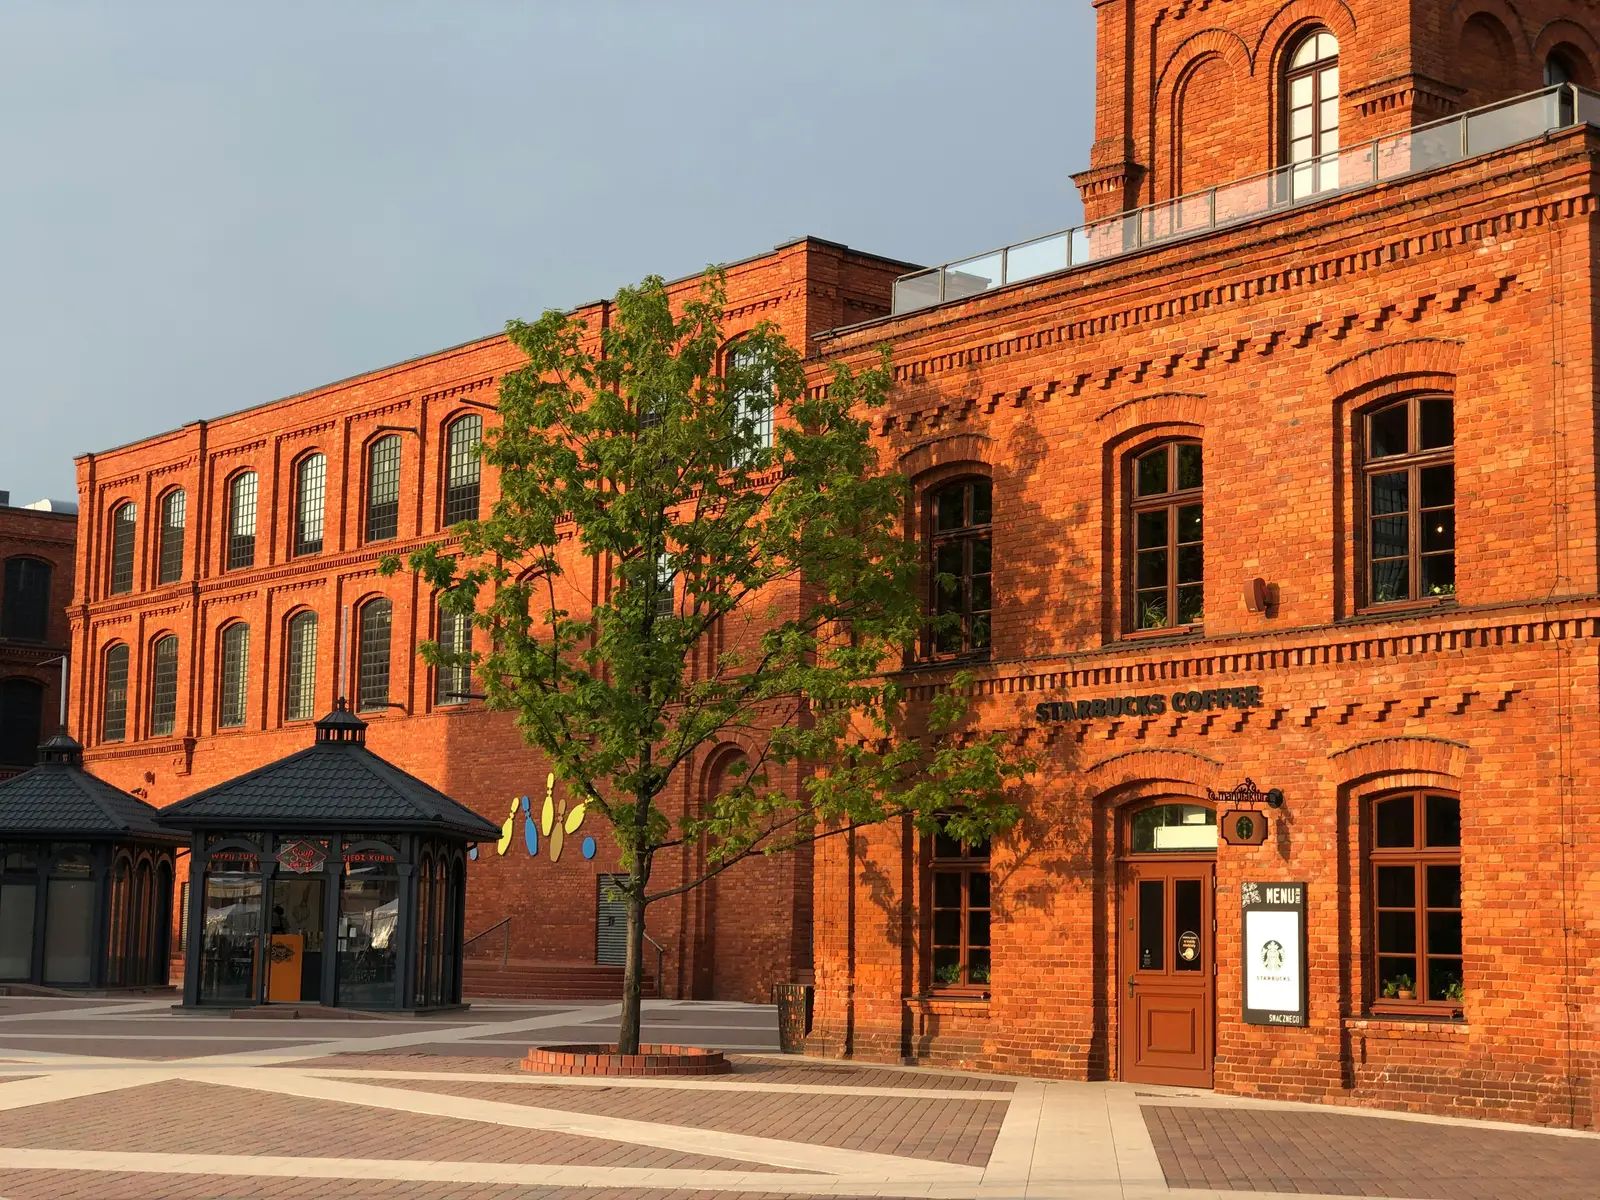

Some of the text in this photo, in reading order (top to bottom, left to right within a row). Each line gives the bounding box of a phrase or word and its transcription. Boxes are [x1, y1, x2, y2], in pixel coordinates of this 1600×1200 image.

[1036, 685, 1264, 722] STARBUCKS COFFEE
[1266, 887, 1295, 904] MENU
